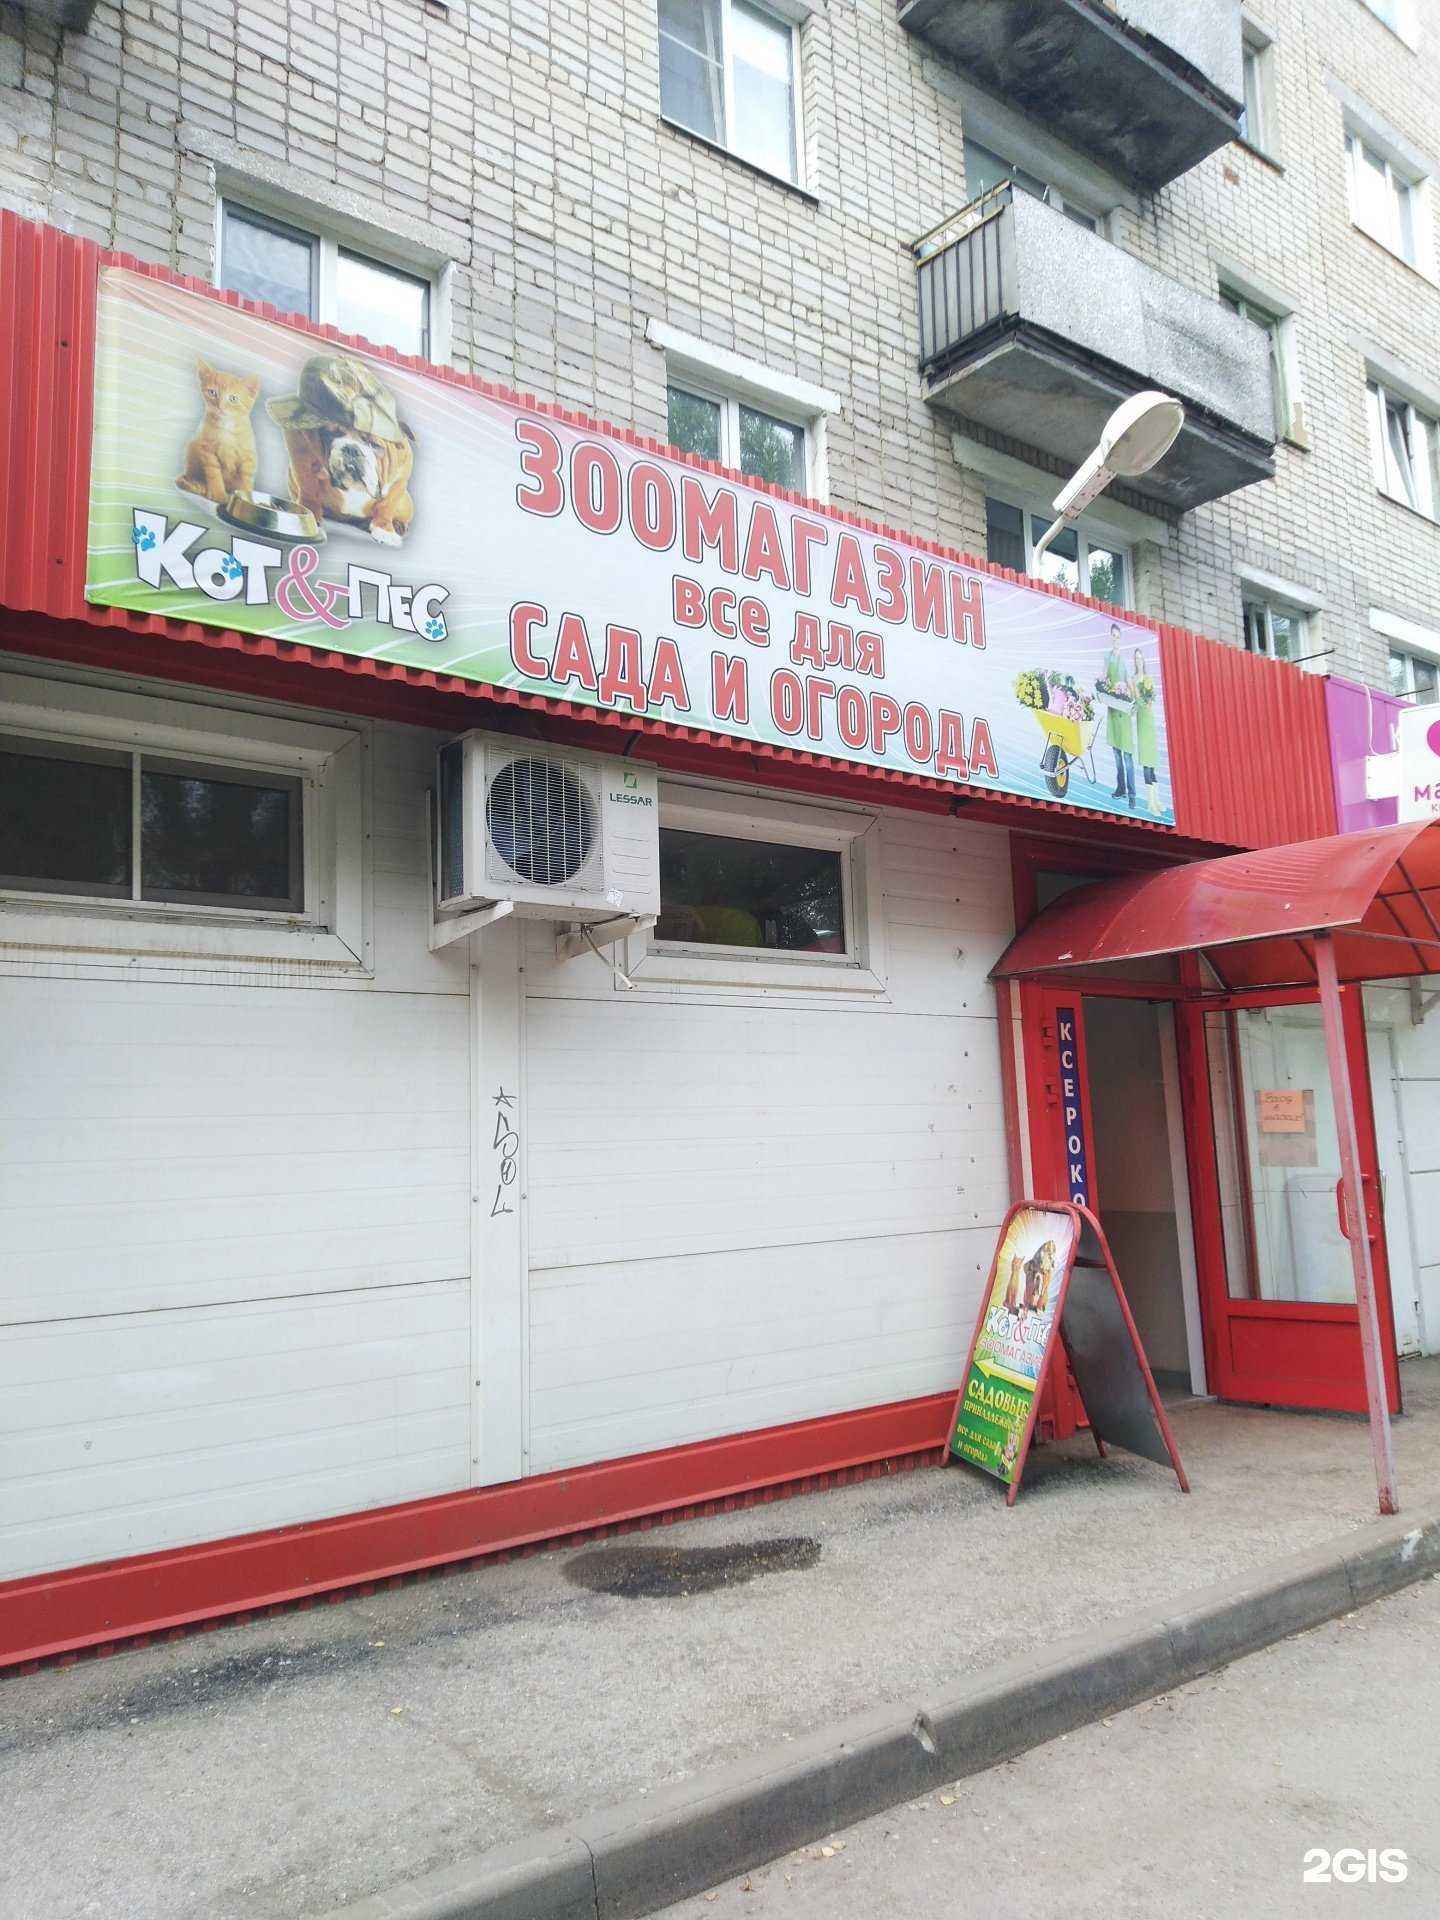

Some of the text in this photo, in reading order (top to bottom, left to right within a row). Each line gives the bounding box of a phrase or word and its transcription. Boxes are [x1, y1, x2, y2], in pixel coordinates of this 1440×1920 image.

[514, 418, 987, 650] ЗООМАГАЗИН
[508, 600, 999, 781] САДА И ОГОРОДА
[608, 792, 653, 808] LESSAR
[968, 1379, 1029, 1418] САДОВЫЕ
